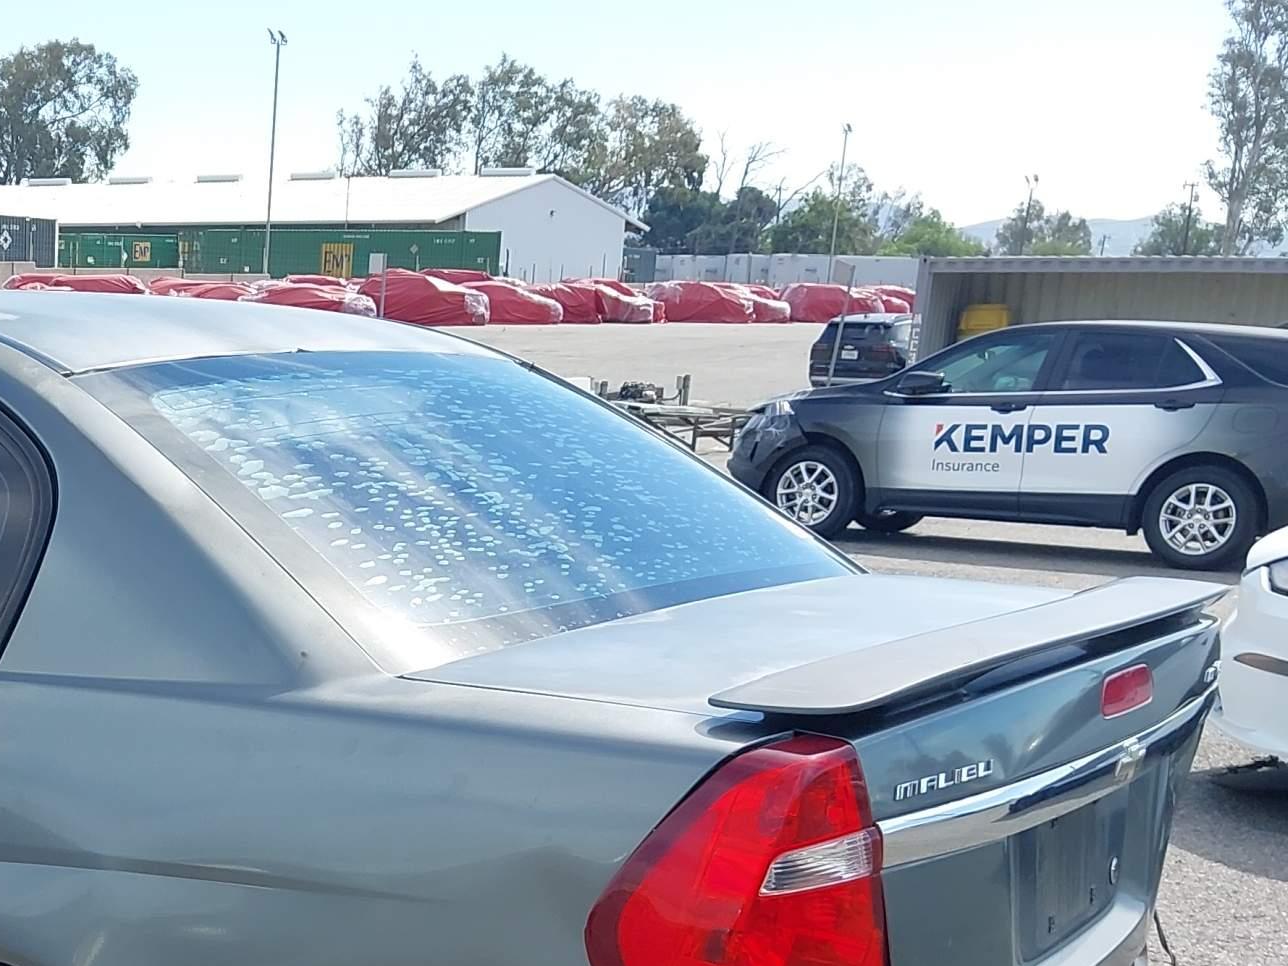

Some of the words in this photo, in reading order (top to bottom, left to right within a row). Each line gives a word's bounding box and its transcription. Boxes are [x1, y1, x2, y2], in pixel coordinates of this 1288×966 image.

[934, 424, 1109, 453] KEMPER
[932, 459, 1000, 472] Insurance
[895, 759, 994, 800] MALIBU
